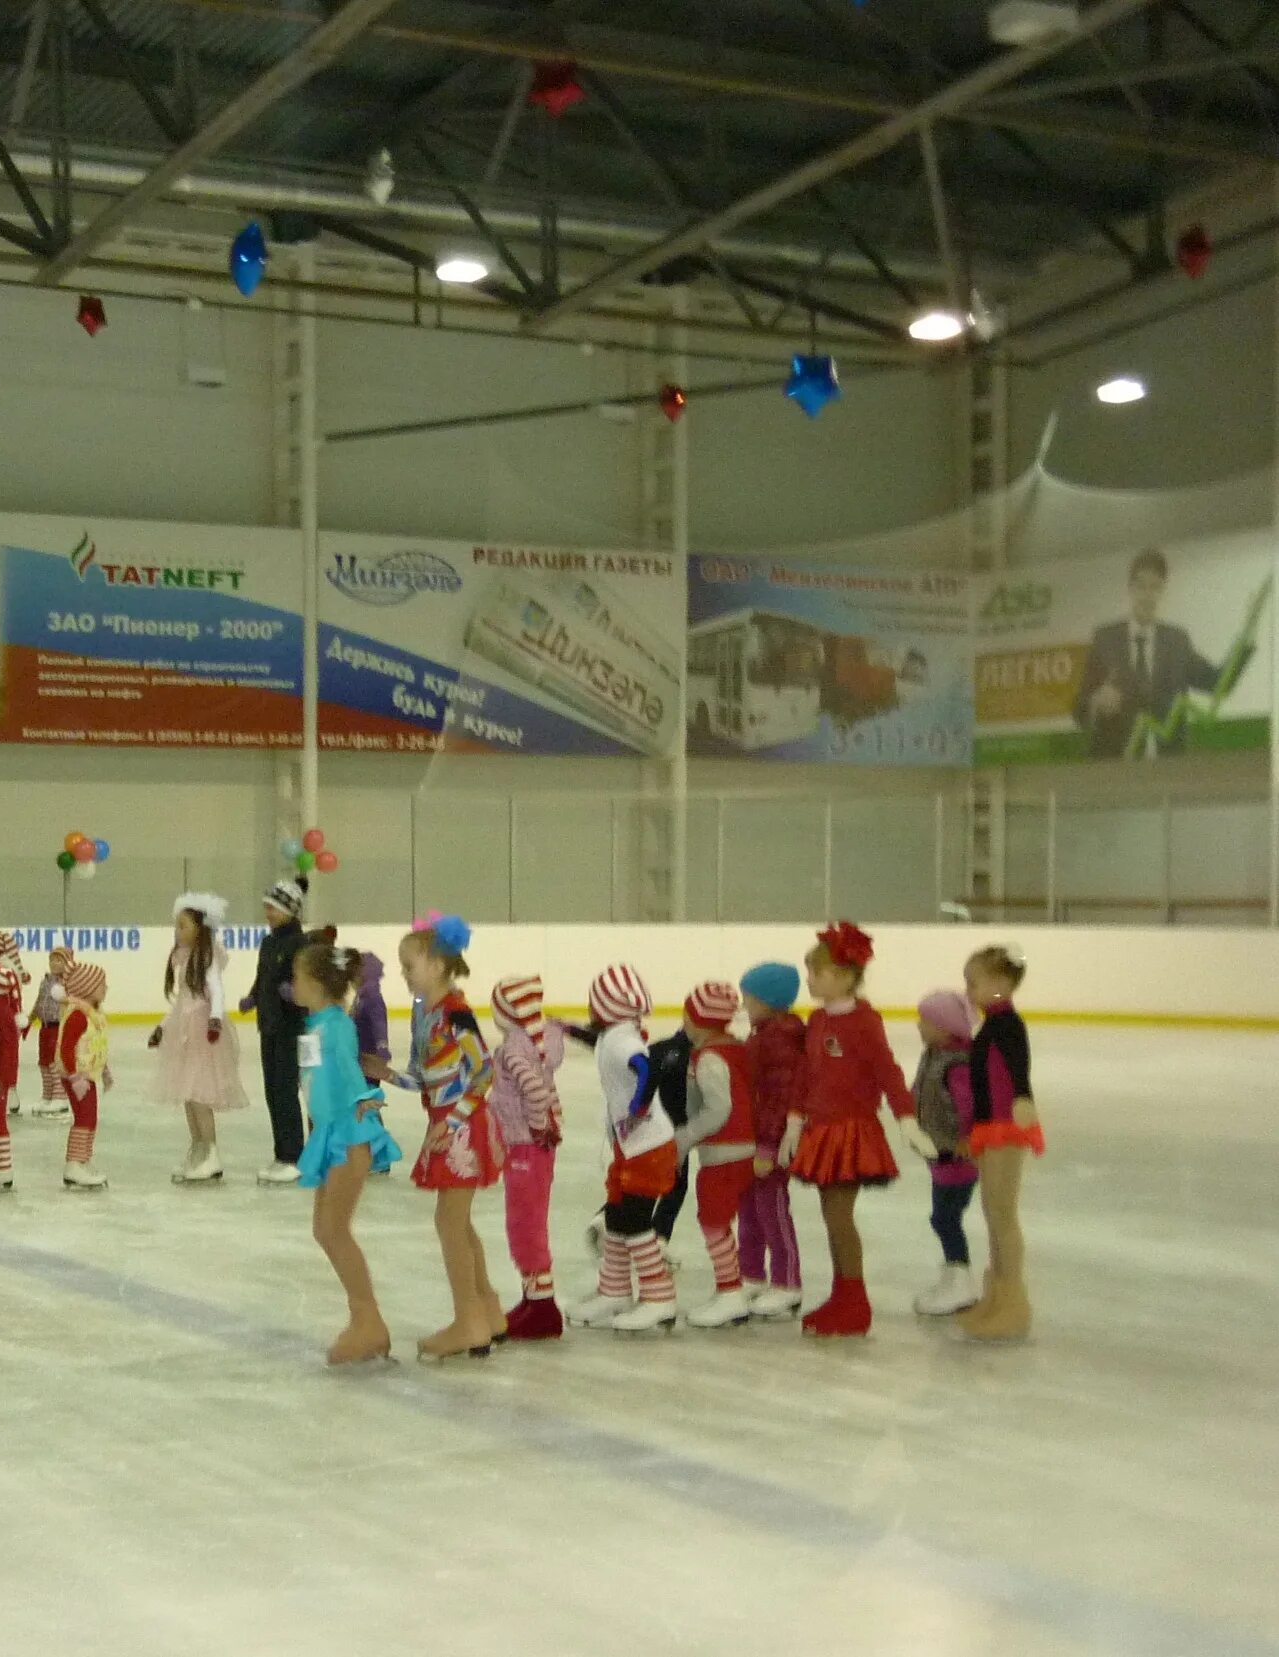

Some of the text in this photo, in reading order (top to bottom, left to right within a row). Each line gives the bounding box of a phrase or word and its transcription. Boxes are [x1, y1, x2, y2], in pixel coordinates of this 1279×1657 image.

[473, 546, 673, 577] РЕДАКЦИЯ ГАЗЕТЫ
[101, 563, 247, 591] TATNEFT
[47, 610, 96, 634] ЗАО
